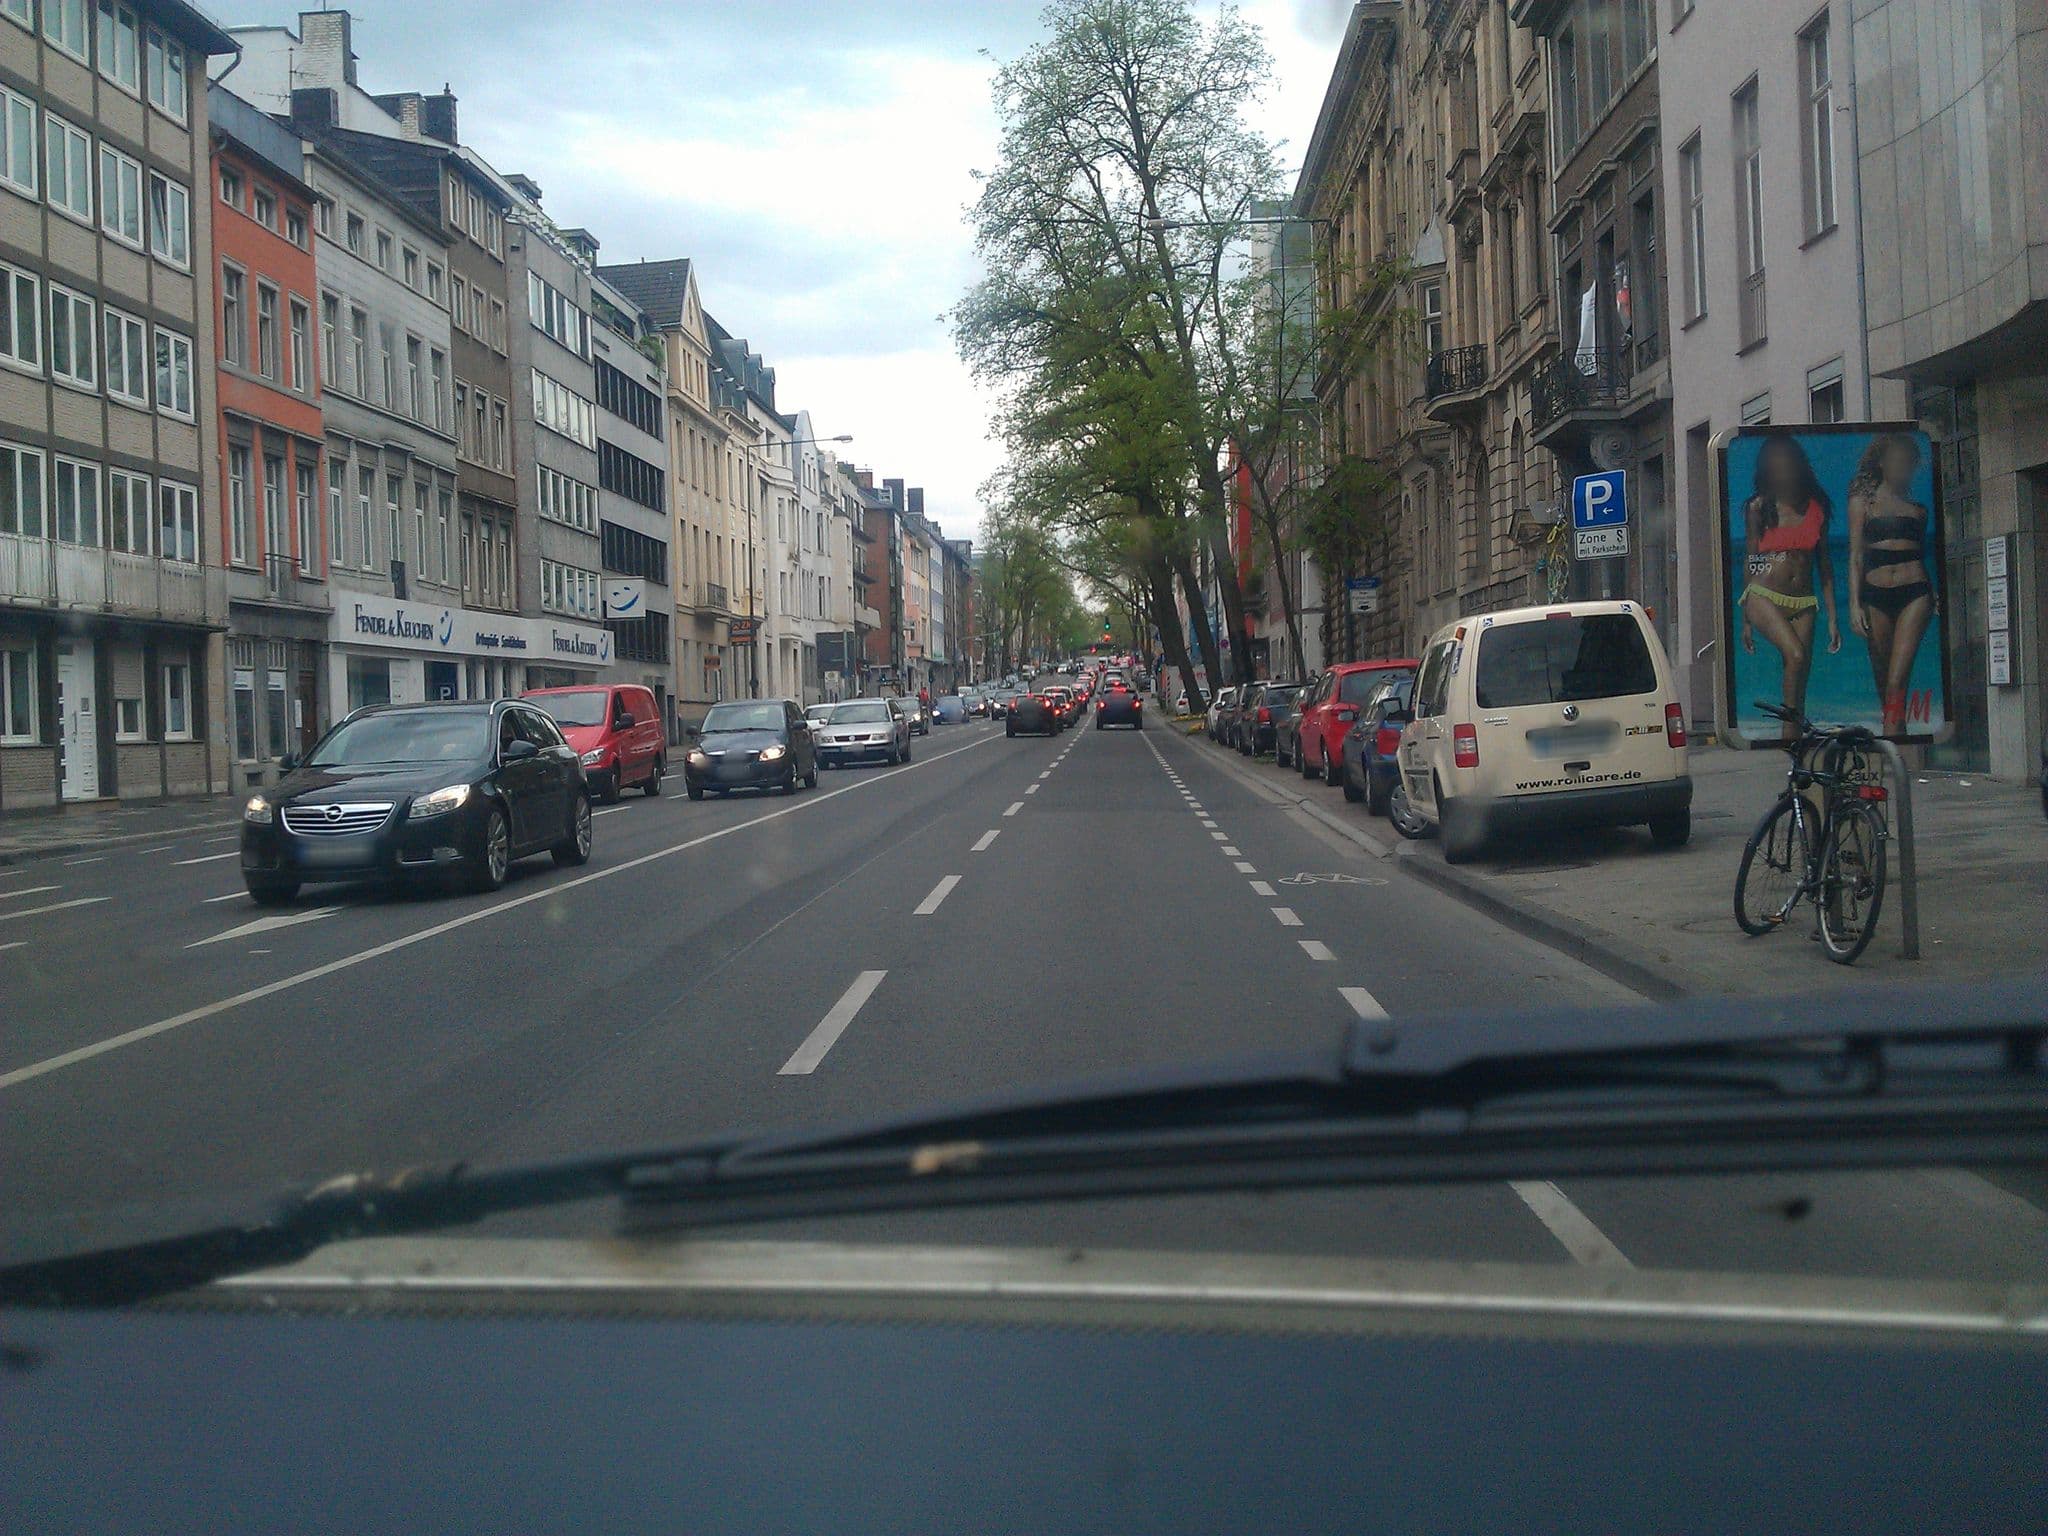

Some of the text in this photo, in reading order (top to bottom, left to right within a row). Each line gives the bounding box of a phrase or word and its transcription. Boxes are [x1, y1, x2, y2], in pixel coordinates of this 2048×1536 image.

[1585, 479, 1613, 521] P
[1579, 529, 1624, 545] Zone S
[1579, 544, 1626, 556] mit Parkschein
[1515, 769, 1642, 790] www.rollicare.de
